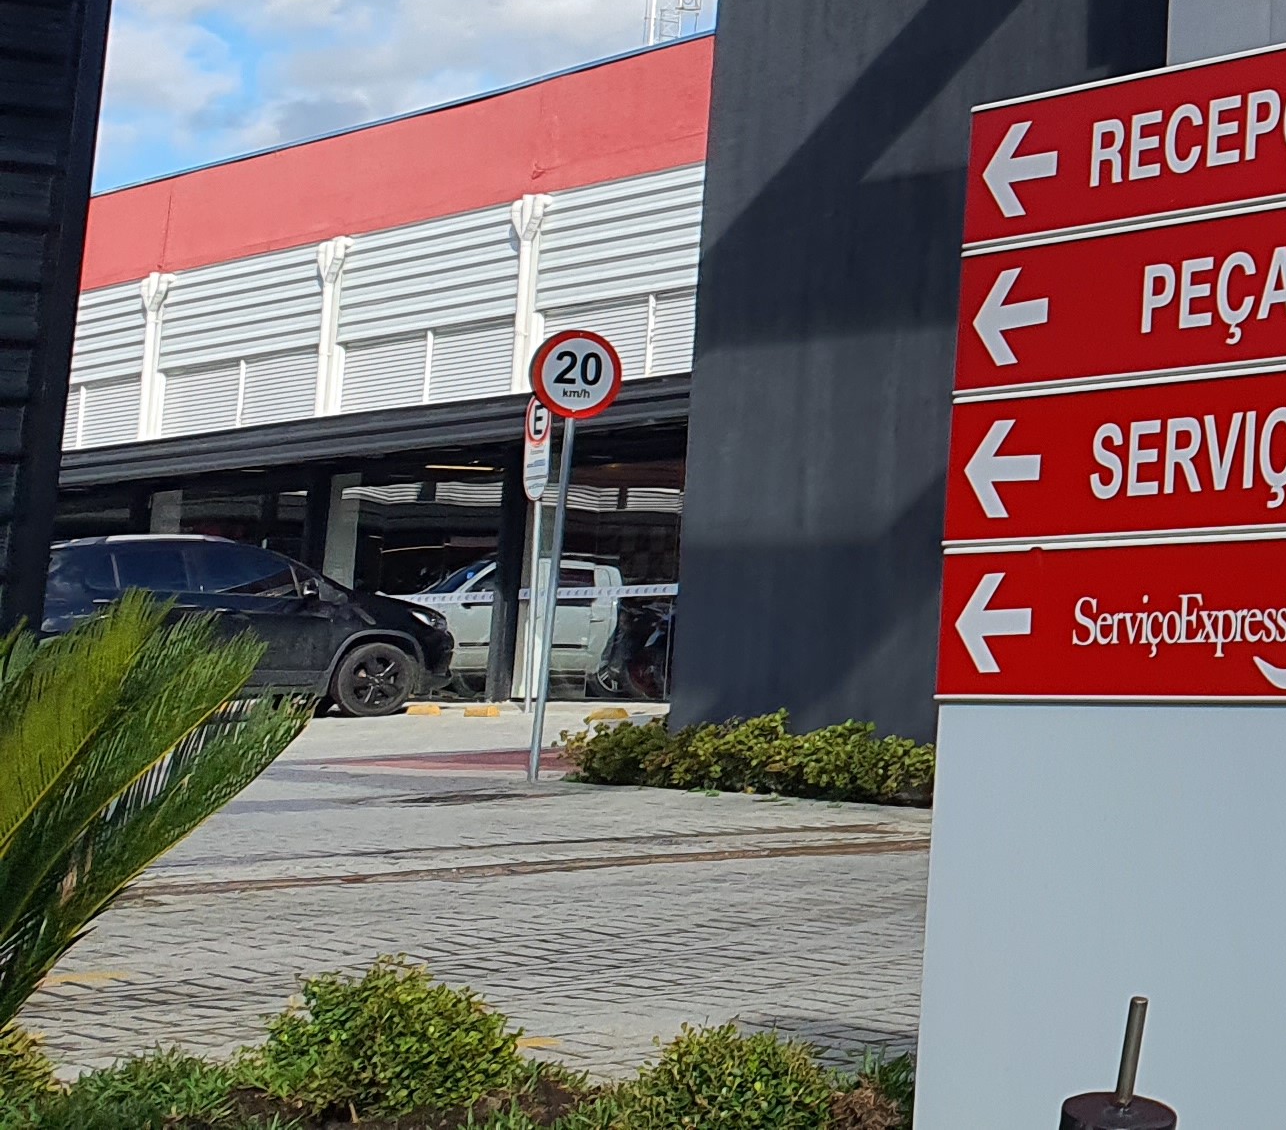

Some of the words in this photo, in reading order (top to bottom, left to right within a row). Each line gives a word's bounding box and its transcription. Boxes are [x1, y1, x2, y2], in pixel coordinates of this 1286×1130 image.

[553, 350, 603, 386] 20
[562, 388, 591, 399] km/h
[534, 405, 544, 435] E
